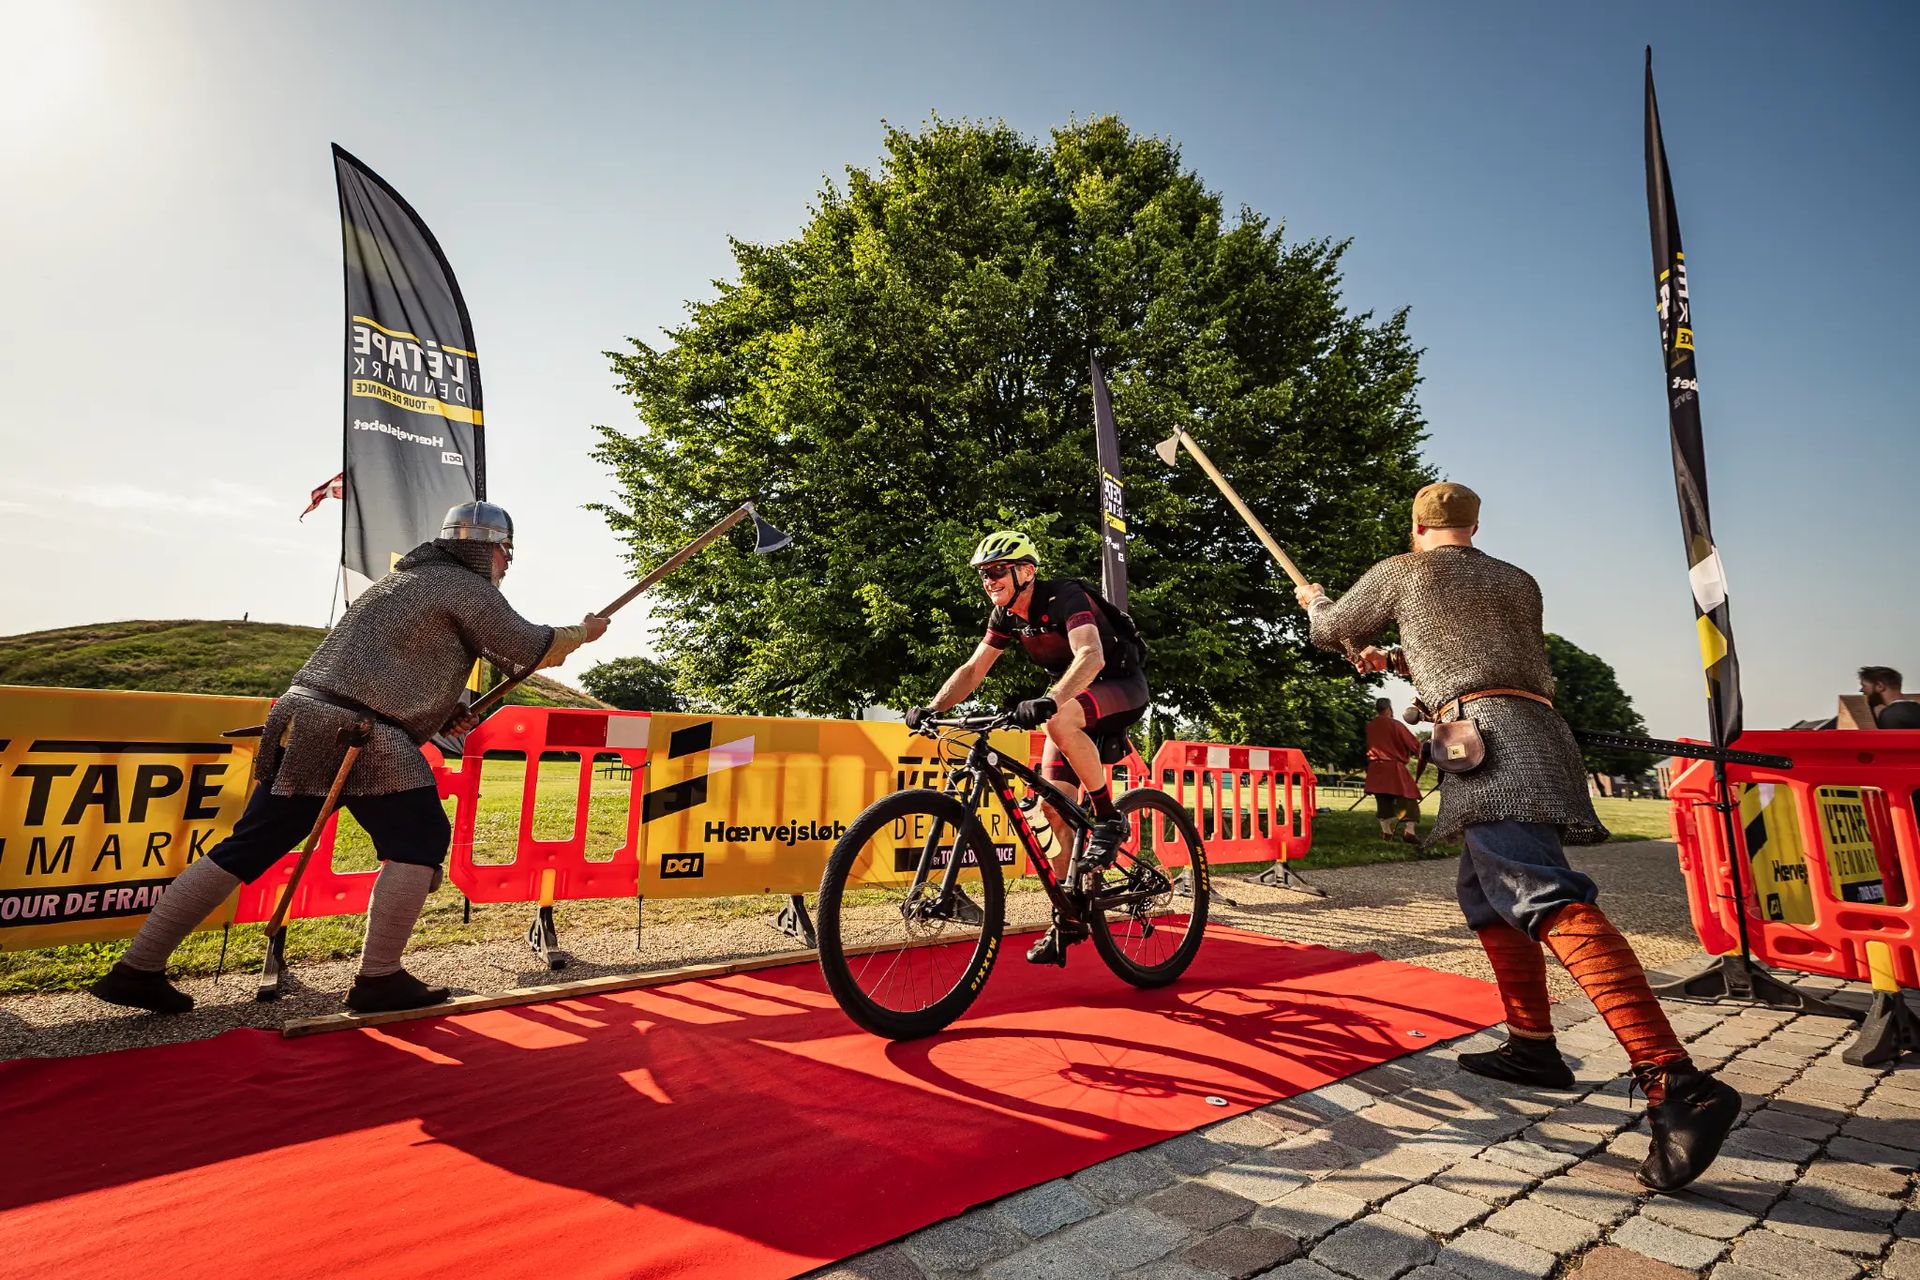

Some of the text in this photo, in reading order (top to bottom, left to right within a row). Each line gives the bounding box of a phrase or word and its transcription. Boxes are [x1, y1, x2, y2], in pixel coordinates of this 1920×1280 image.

[0, 763, 229, 826] TAPE
[665, 858, 700, 873] DGI
[0, 894, 60, 920] OUR
[64, 891, 99, 915] DE
[970, 936, 997, 990] MAXXIS
